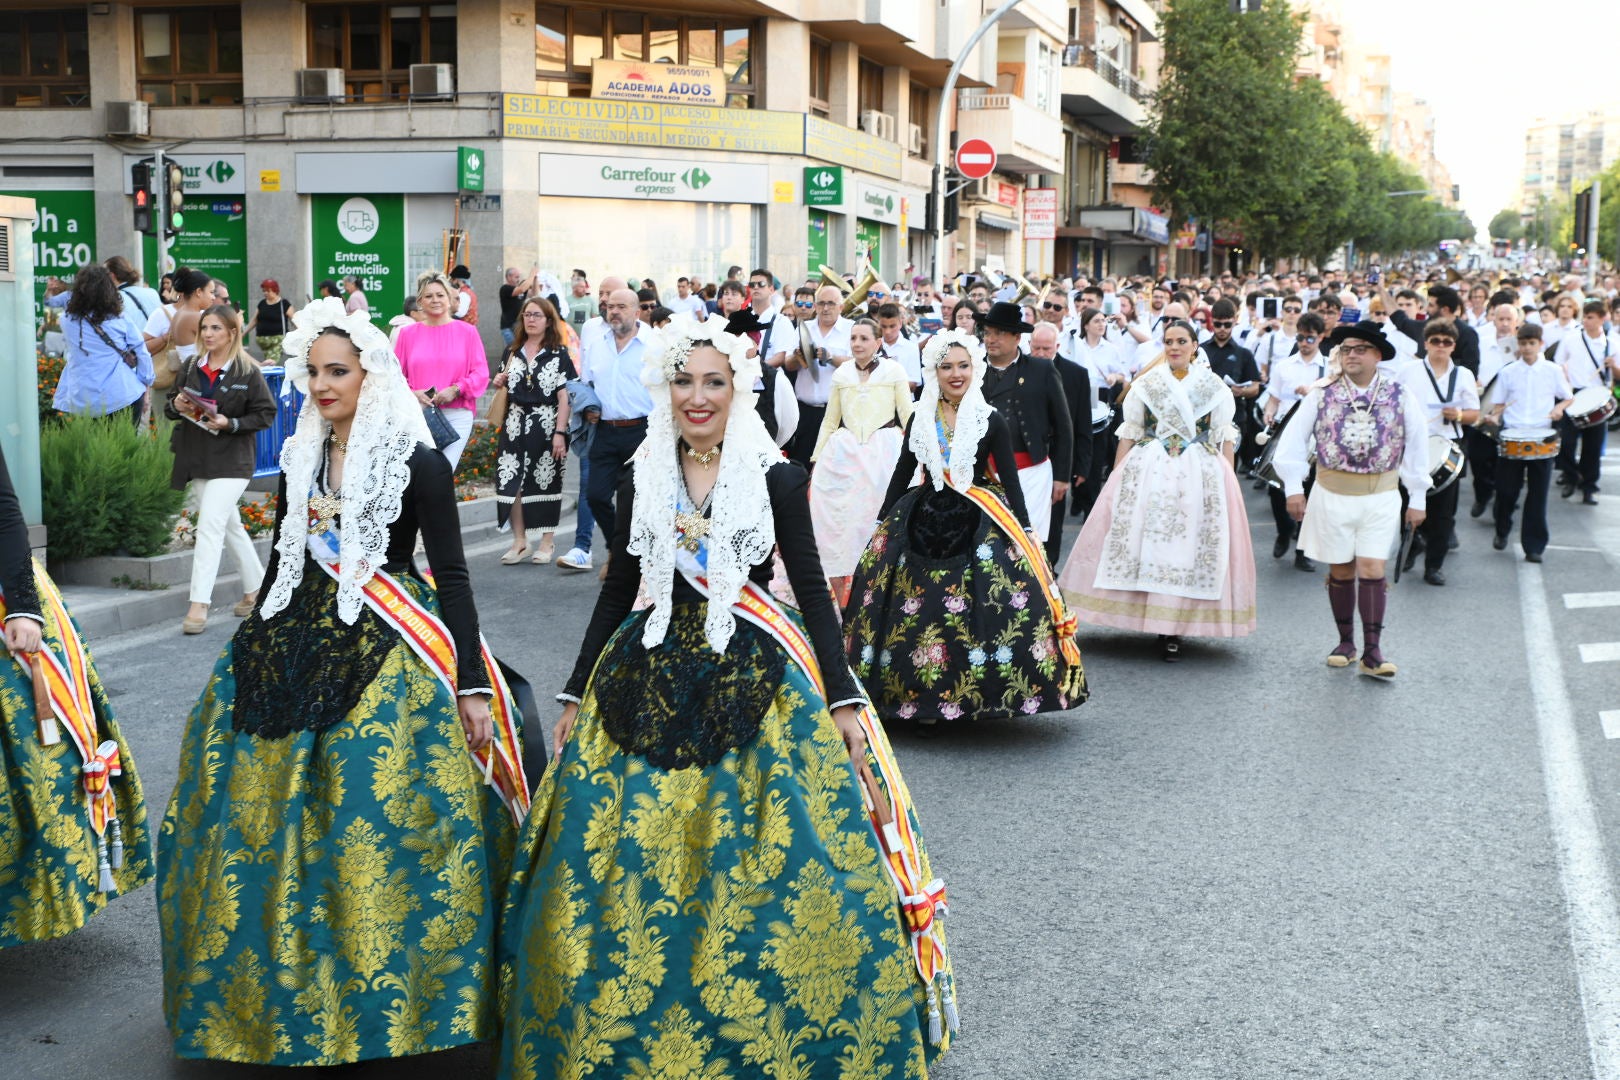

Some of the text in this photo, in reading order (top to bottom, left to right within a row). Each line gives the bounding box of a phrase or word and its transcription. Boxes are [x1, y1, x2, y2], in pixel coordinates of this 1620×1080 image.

[608, 81, 711, 96] ACADEMIA ADOS
[509, 96, 655, 121] SELECTIVIDAD
[664, 106, 711, 120] ACCESO
[507, 122, 658, 144] PRIMARIA-SECUNDARIA
[666, 133, 710, 147] MEDIO
[718, 136, 727, 148] Y
[601, 165, 676, 183] Carrefour
[635, 184, 676, 197] express
[809, 188, 837, 196] Carrefour
[66, 219, 78, 233] a
[335, 252, 379, 264] Entrega
[328, 264, 390, 275] a domicilio
[336, 276, 383, 294] gtis
